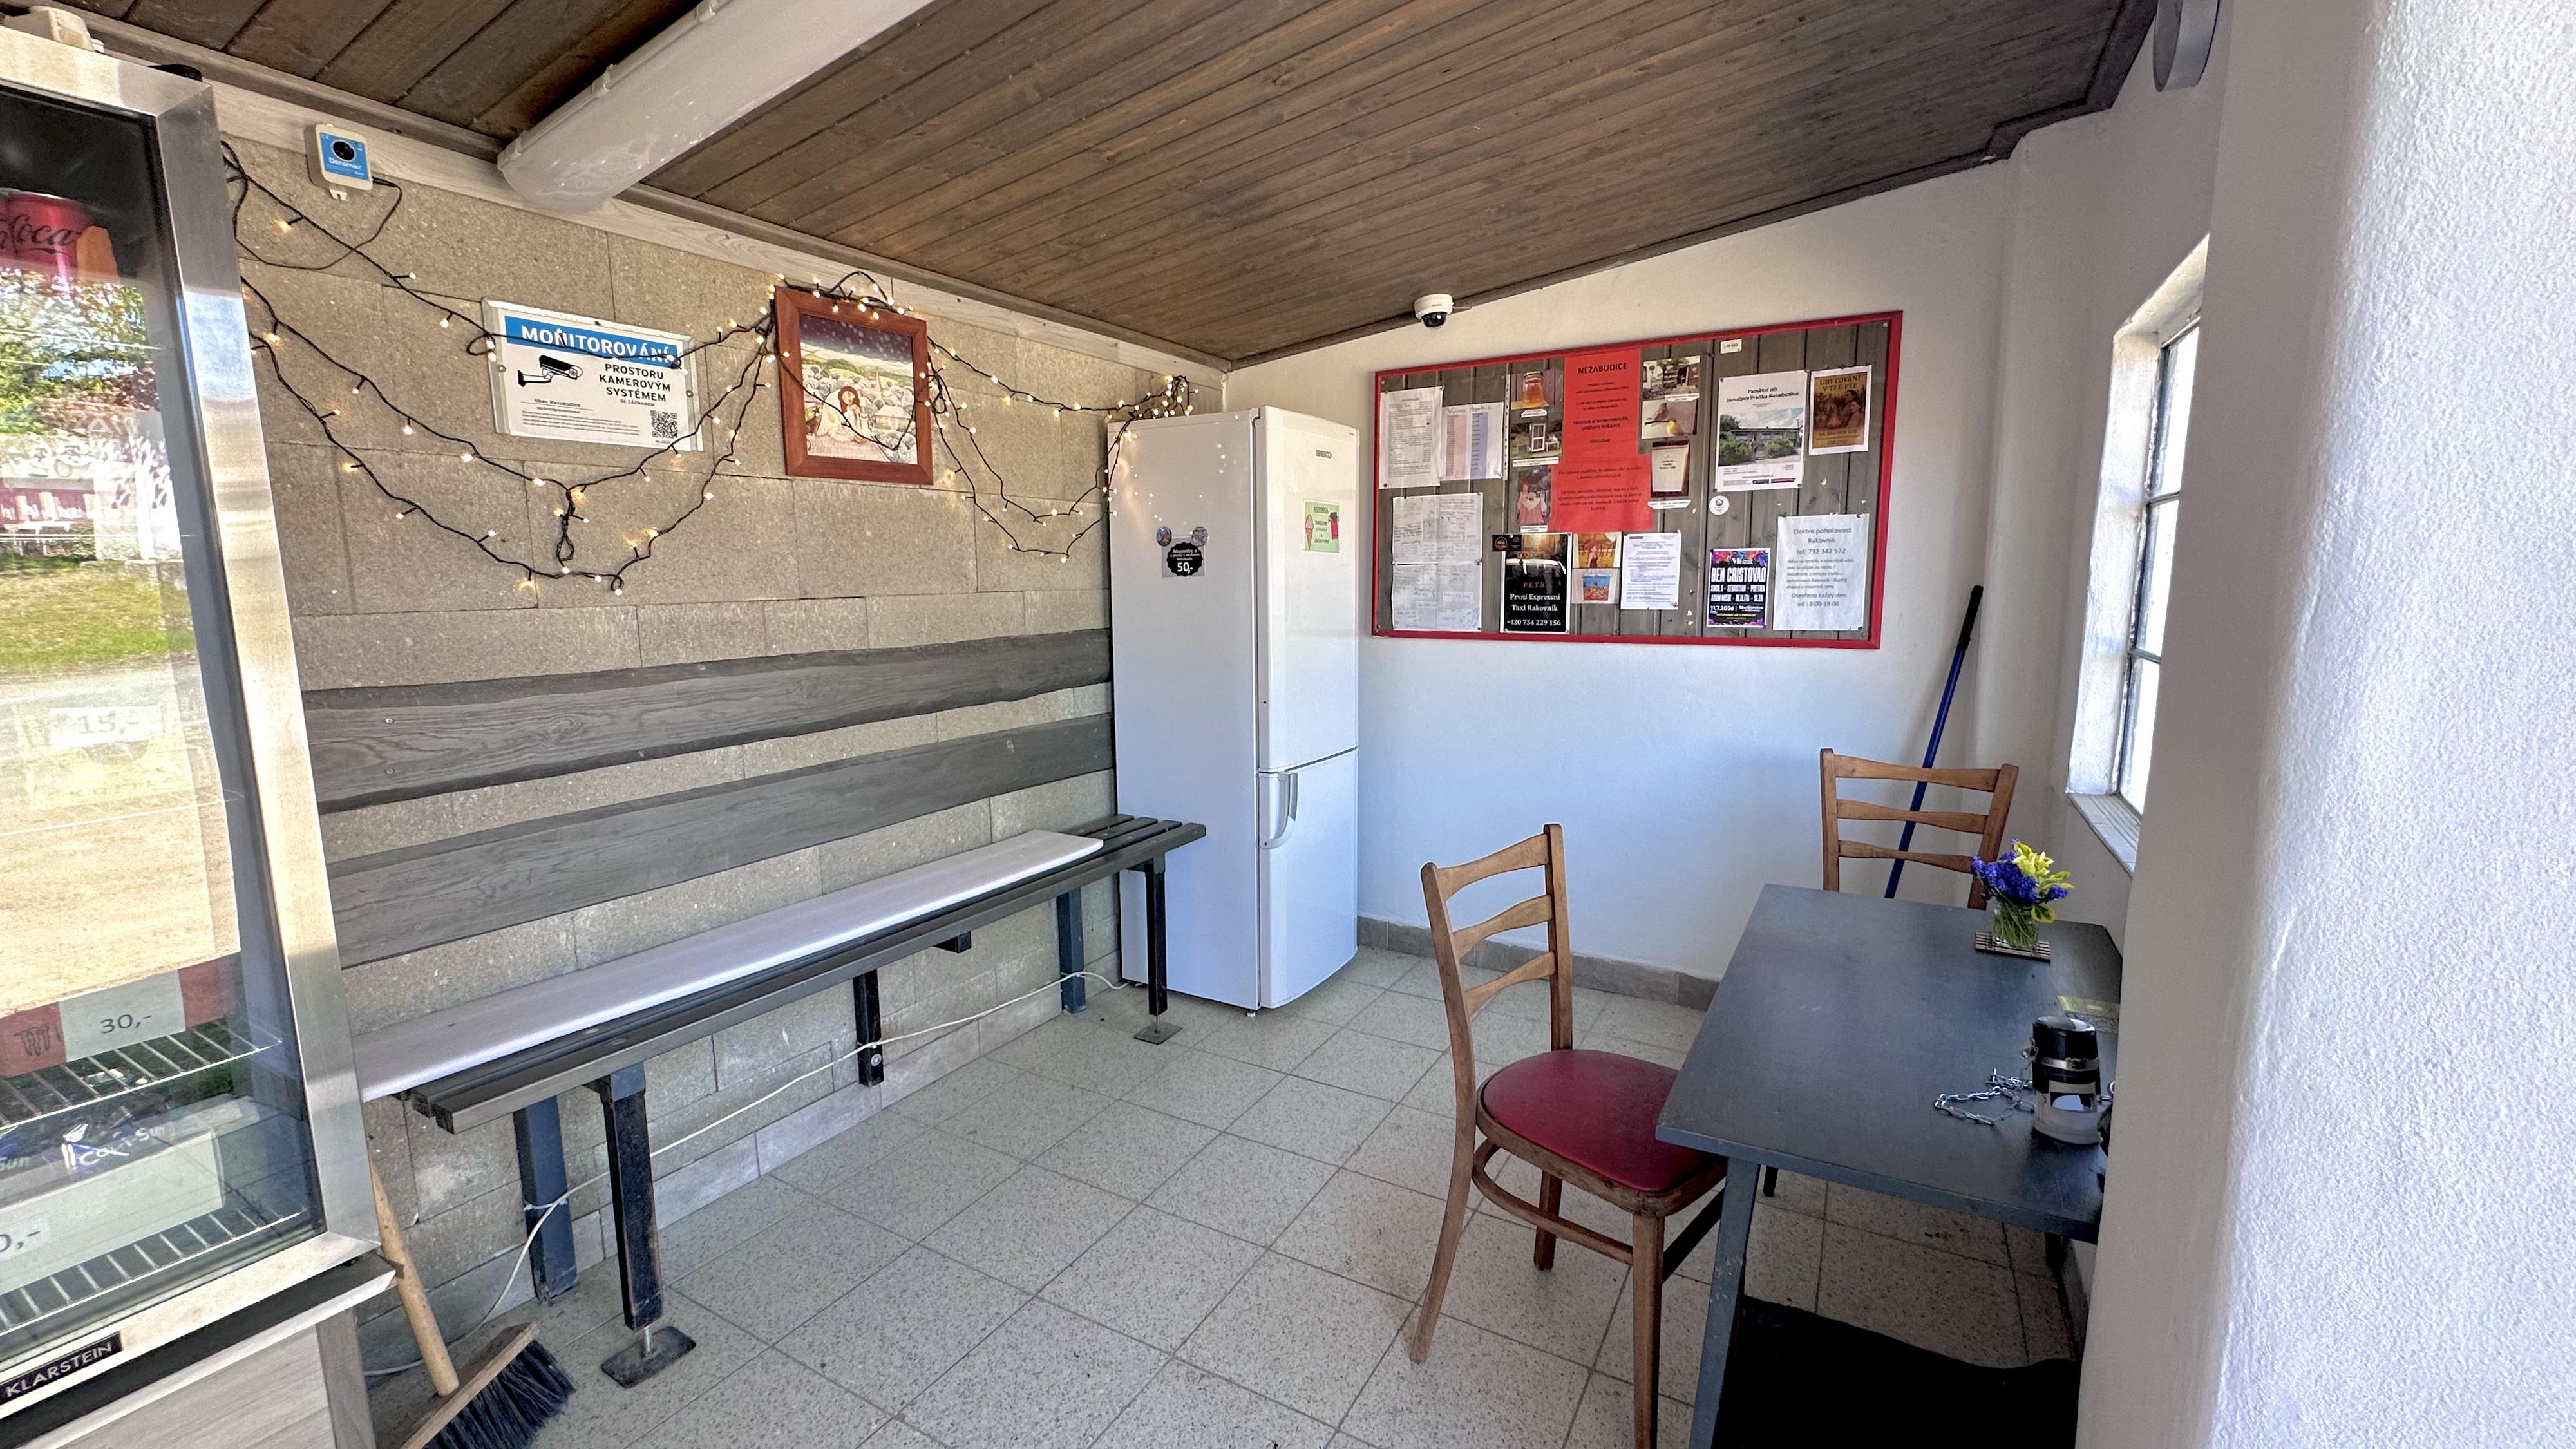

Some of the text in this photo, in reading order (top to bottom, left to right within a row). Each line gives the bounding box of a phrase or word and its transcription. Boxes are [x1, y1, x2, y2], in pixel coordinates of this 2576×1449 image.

[522, 325, 671, 363] MONITOROVÁNÍ
[605, 363, 663, 379] PROSTORU
[1578, 362, 1628, 375] NEZABUDICE
[599, 374, 670, 392] KAMEROVÝM
[606, 387, 666, 402] SYSTÉMEM
[550, 399, 581, 408] Nezabudice
[1177, 562, 1193, 574] 50,-
[1710, 567, 1725, 582] BEN
[100, 1014, 152, 1034] 30,-
[6, 1342, 111, 1397] KLARSTEIN
